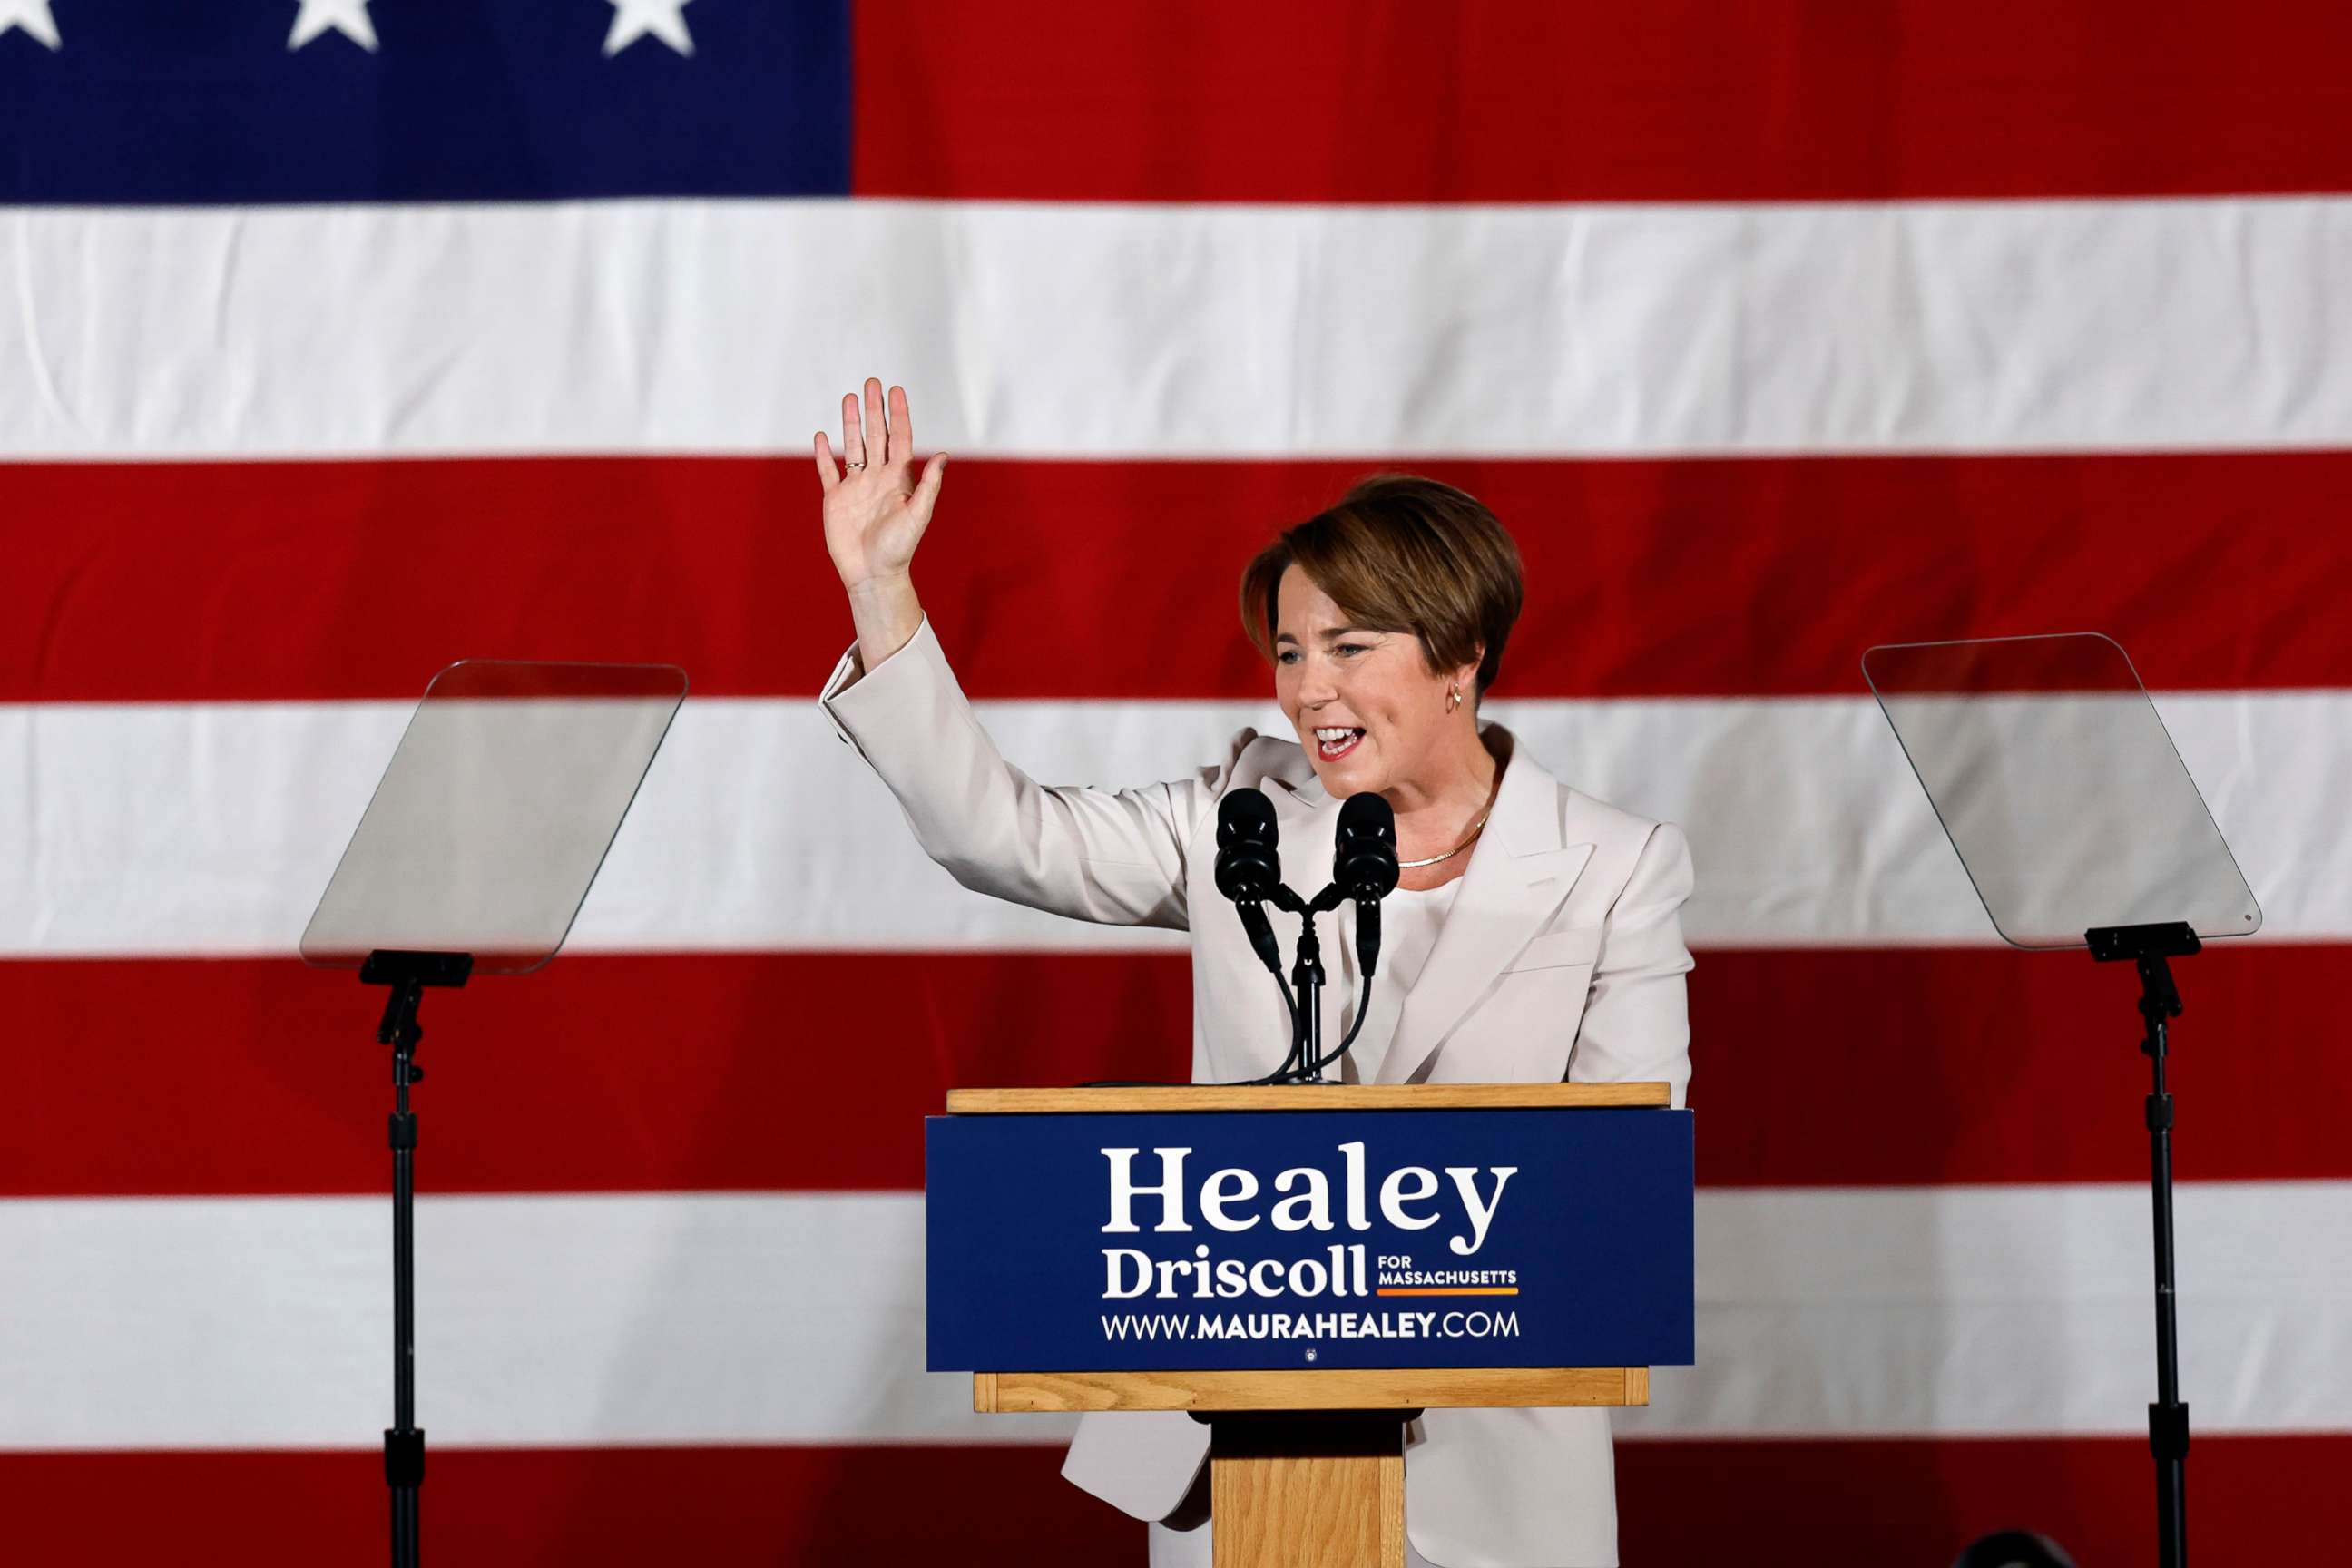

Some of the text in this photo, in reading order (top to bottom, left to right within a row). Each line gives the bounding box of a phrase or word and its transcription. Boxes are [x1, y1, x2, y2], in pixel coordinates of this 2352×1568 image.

[1101, 1142, 1517, 1255] Healey
[1102, 1244, 1368, 1298] Driscoll
[1378, 1256, 1411, 1269] FOR
[1379, 1270, 1516, 1285] MASSACHUSETTS
[1102, 1311, 1519, 1340] WWW.MAURAHEALEY.COM
